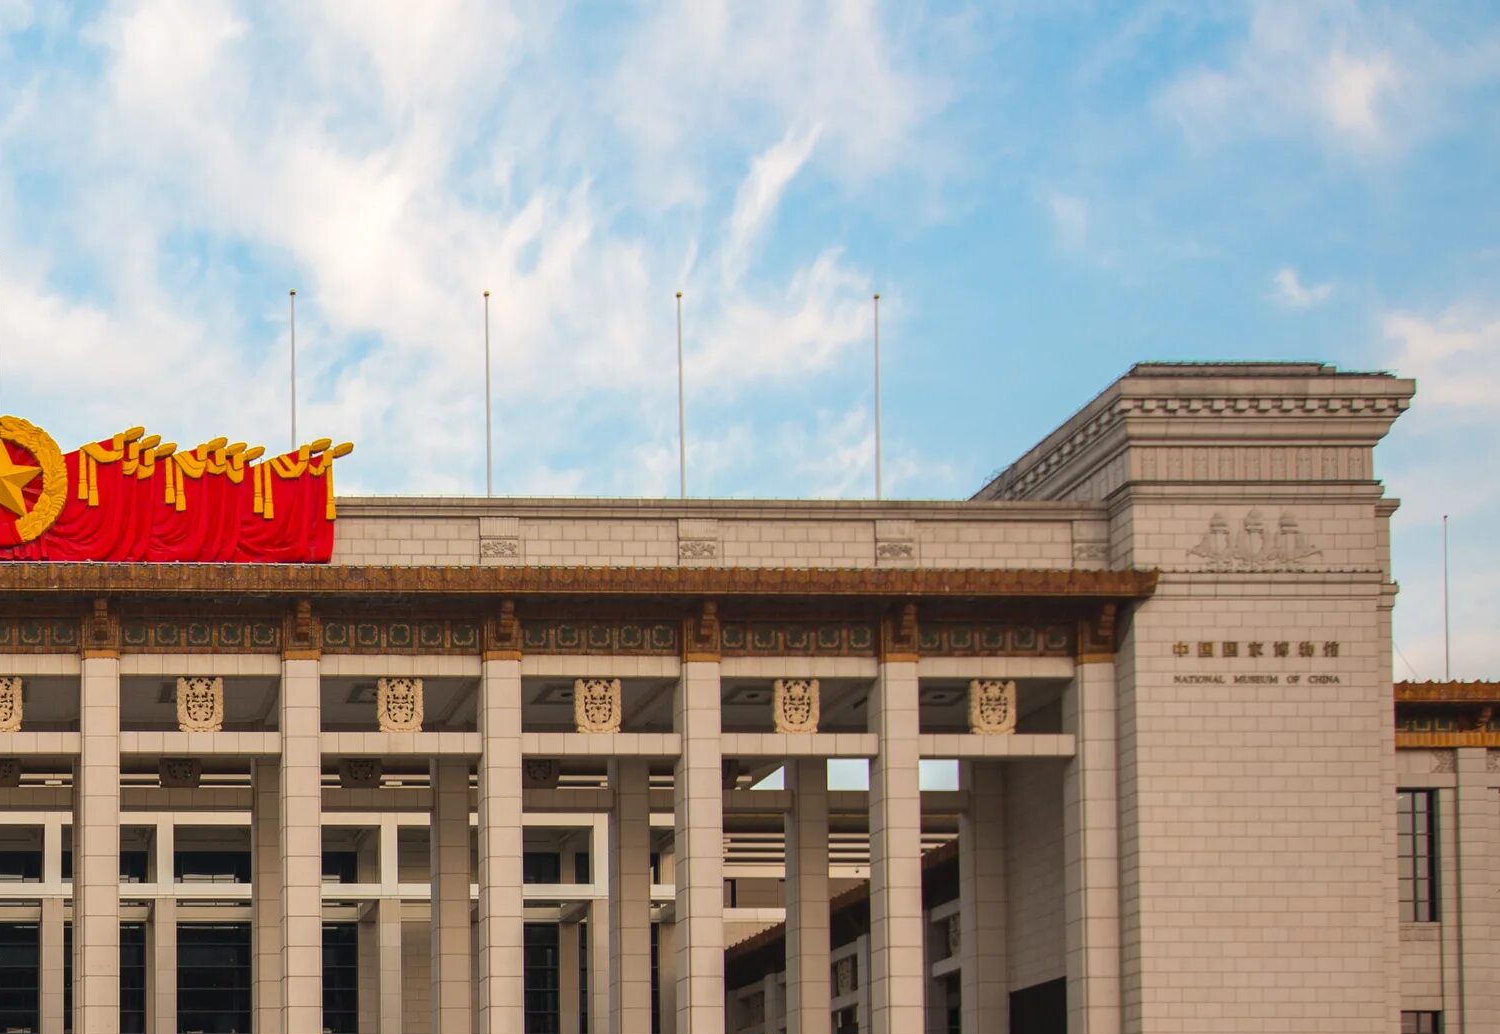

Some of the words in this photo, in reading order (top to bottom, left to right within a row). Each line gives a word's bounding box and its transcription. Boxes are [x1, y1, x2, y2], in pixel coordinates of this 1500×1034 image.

[1172, 641, 1340, 657] 中国国家博物馆
[1174, 675, 1225, 683] NATIONAL
[1234, 675, 1278, 683] MUSEUM
[1287, 675, 1300, 683] OF
[1308, 675, 1340, 683] CHINA
